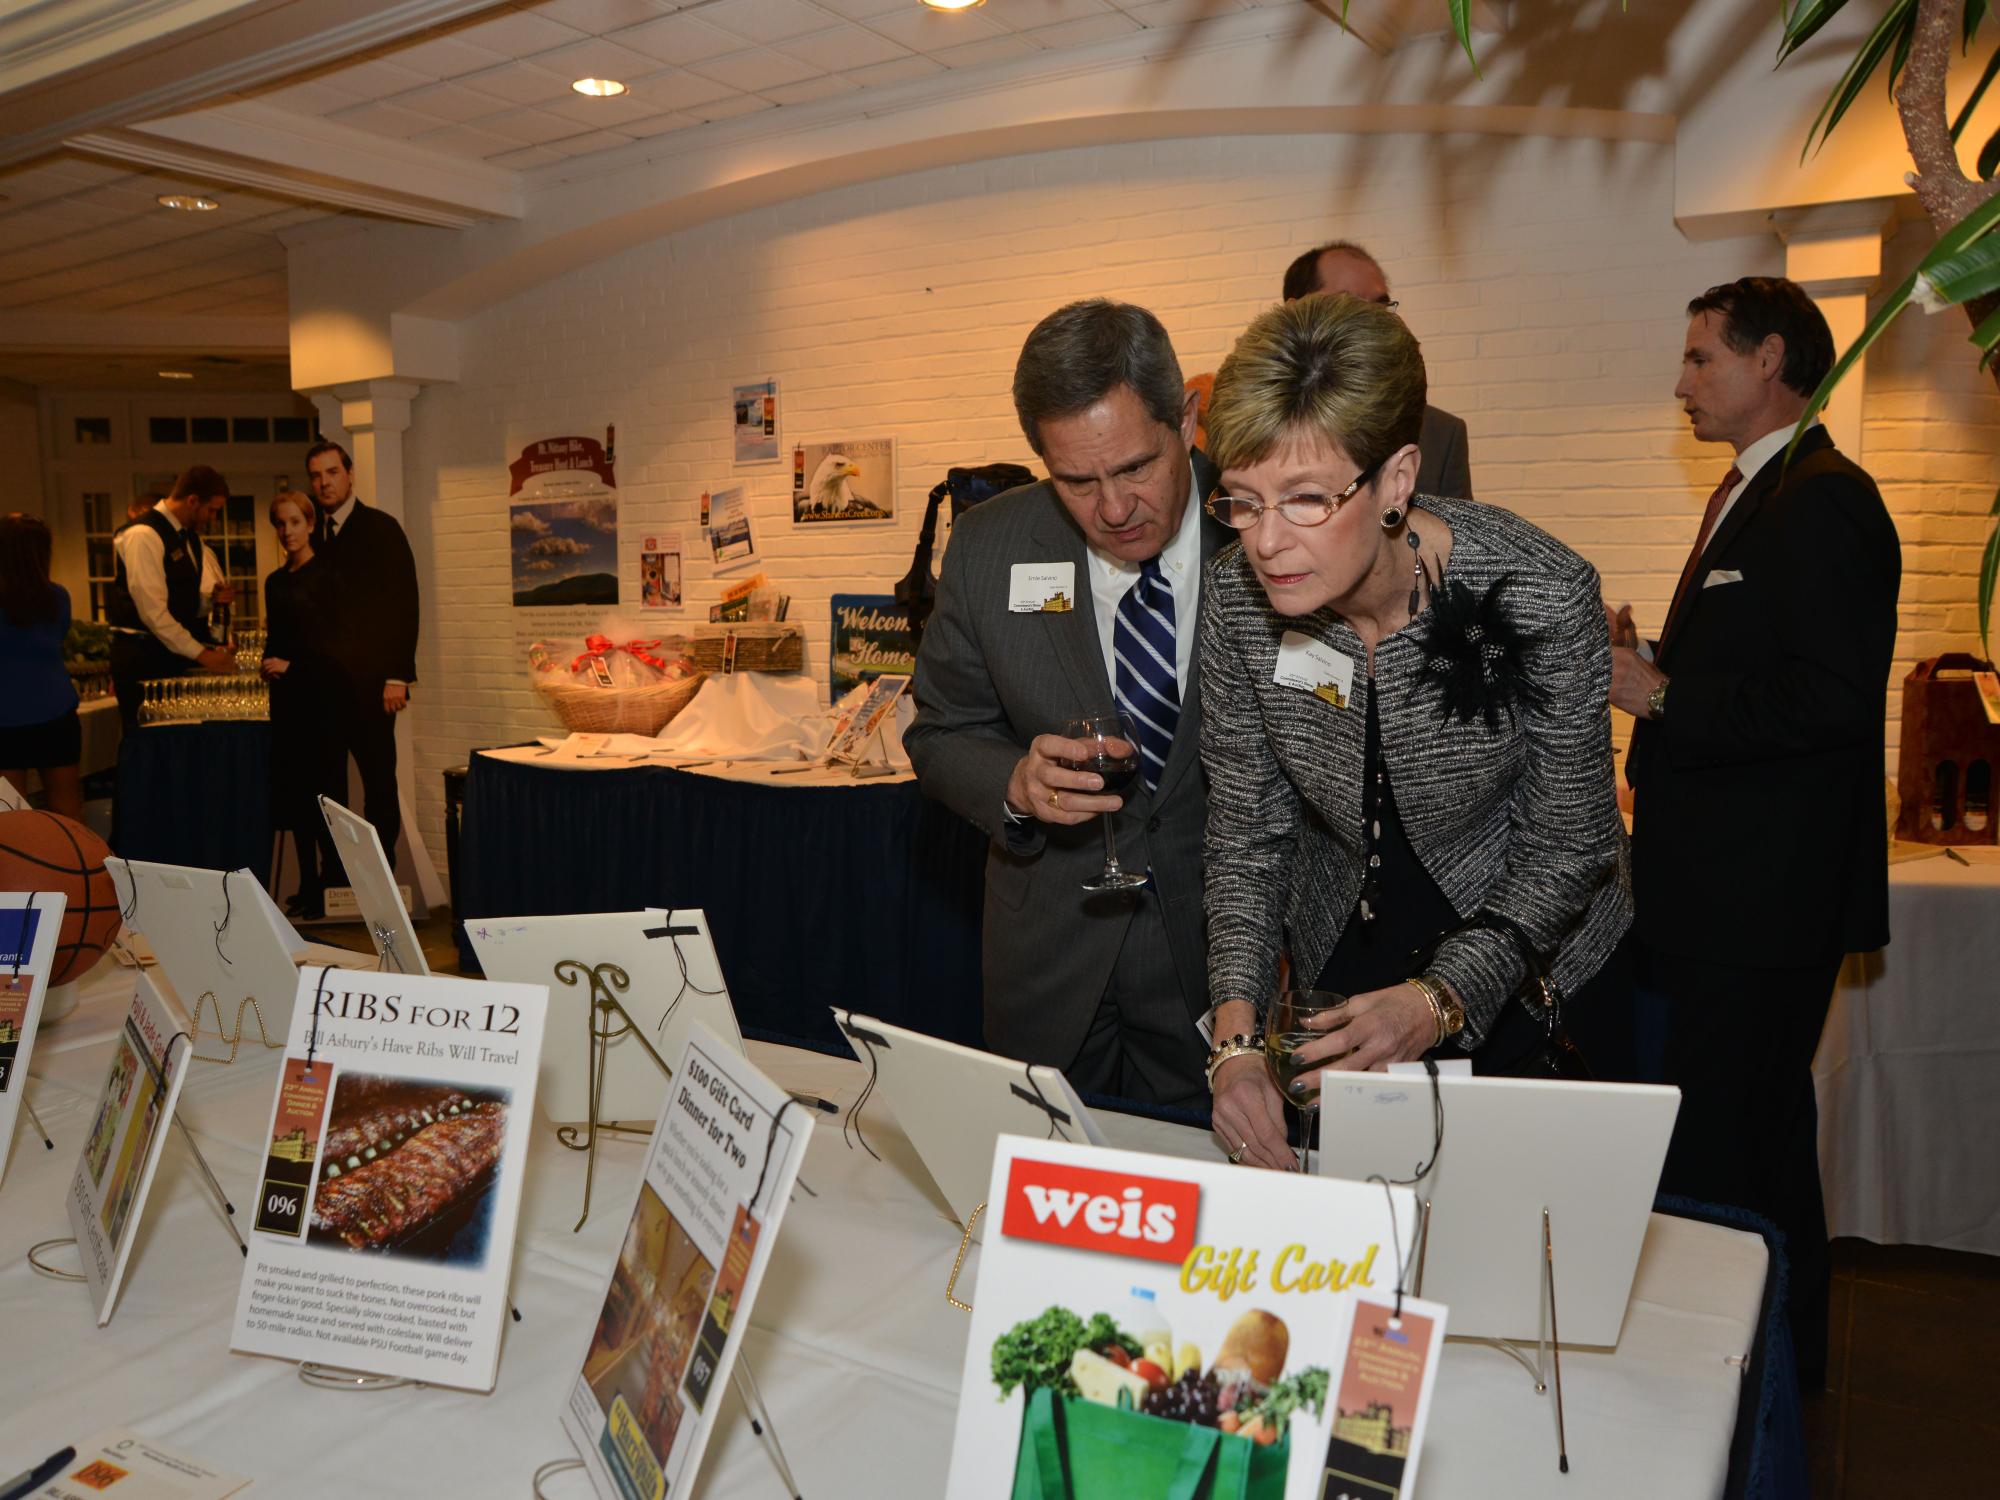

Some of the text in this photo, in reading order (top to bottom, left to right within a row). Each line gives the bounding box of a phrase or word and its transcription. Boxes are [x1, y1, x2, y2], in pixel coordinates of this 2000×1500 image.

[856, 440, 890, 451] CENTER
[851, 641, 911, 666] Home
[309, 989, 520, 1037] RIBS FOR 12
[304, 1030, 519, 1066] Bll Asbury's Have Ribs Will Travel
[688, 1059, 755, 1132] $100 Gift Card
[678, 1086, 746, 1168] Dinner for Two
[268, 1194, 298, 1216] 096
[1023, 1185, 1176, 1244] weis
[257, 1262, 267, 1273] Pit
[269, 1265, 301, 1278] smoked
[302, 1270, 318, 1281] and
[318, 1272, 345, 1286] grilled
[346, 1275, 355, 1286] to
[402, 1285, 425, 1297] these
[426, 1289, 447, 1301] pork
[448, 1291, 464, 1303] ribs
[465, 1294, 482, 1305] will
[1179, 1238, 1380, 1301] Gift Card
[255, 1279, 476, 1319] make you want to suck the bones. Not overcooked, but
[326, 1301, 360, 1318] Specially
[363, 1307, 383, 1320] slow
[383, 1311, 416, 1326] cooked,
[418, 1315, 447, 1330] basted
[448, 1321, 468, 1333] with
[246, 1319, 470, 1365] to 50-mile radius. Not available PSU Football game day.
[249, 1303, 473, 1349] homemade sauce and served with coleslaw. Will deliver
